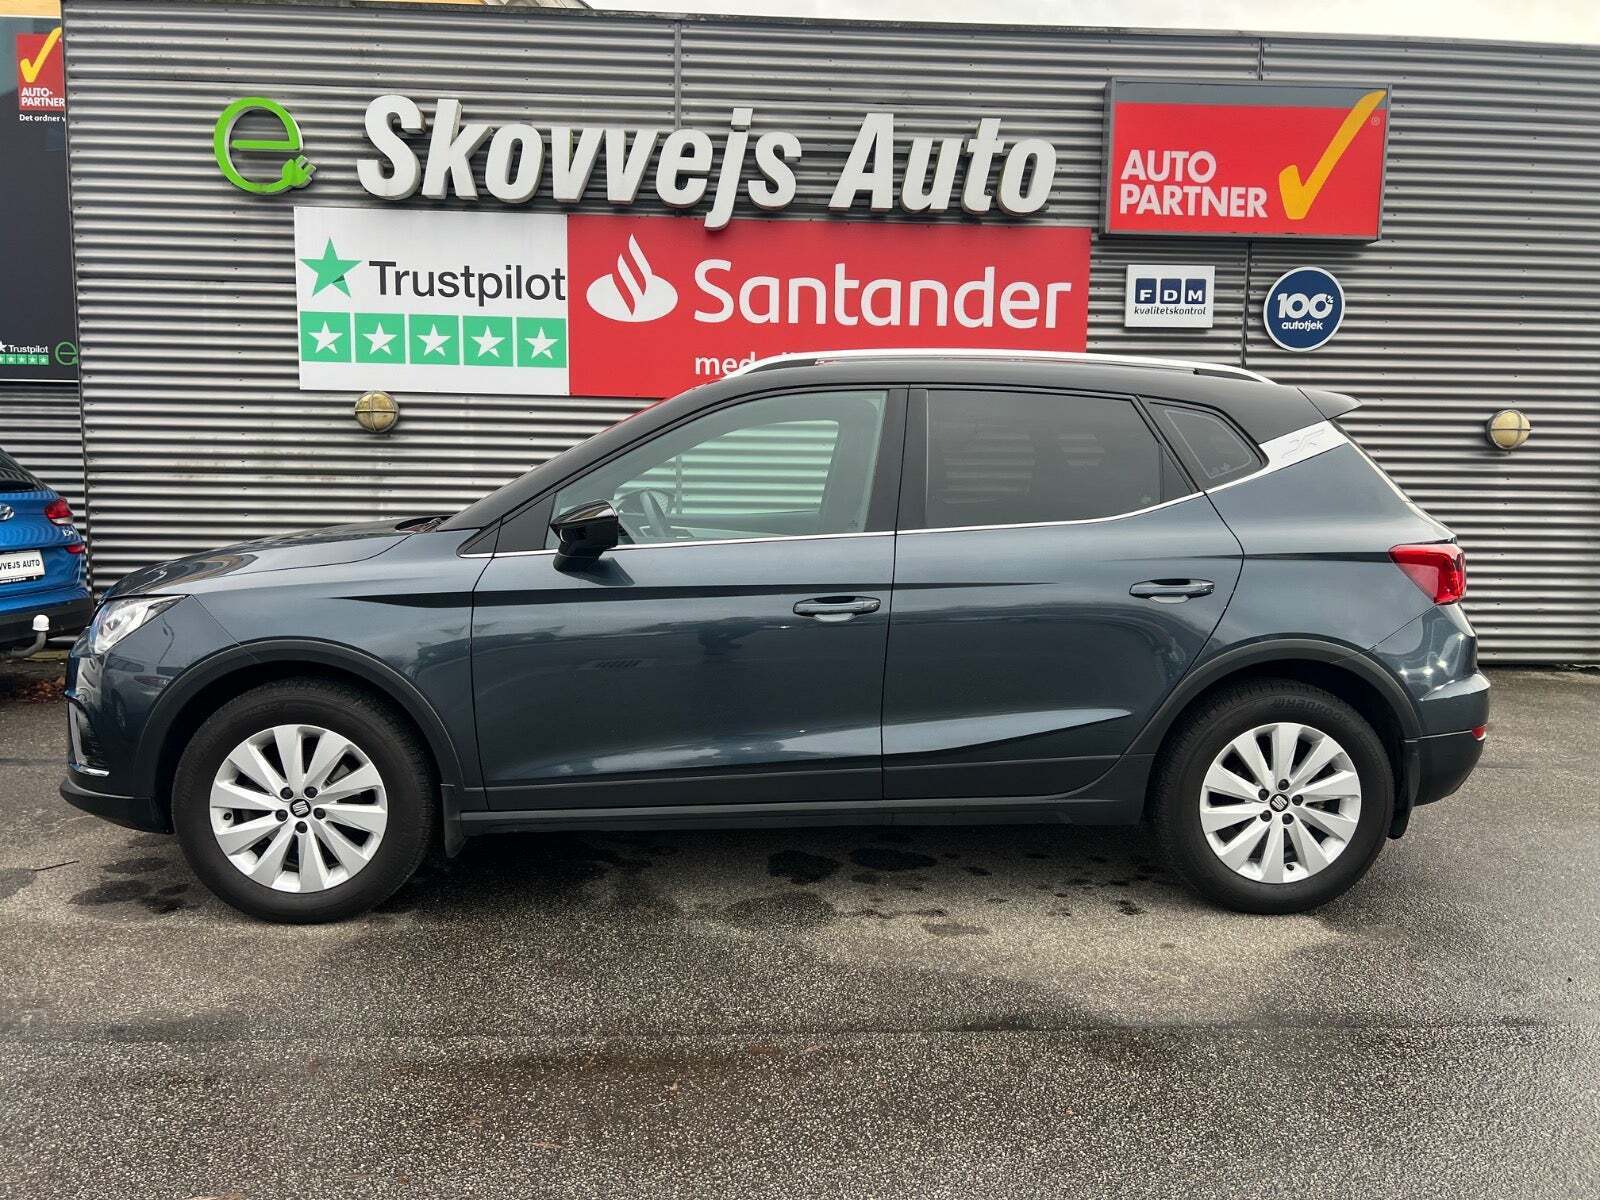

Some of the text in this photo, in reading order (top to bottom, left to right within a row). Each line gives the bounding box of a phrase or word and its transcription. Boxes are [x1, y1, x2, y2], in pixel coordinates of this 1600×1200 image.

[21, 87, 53, 97] AUTO-
[21, 97, 65, 107] PARTNER
[357, 94, 1058, 231] Skovvejs Auto
[1120, 149, 1217, 183] AUTO
[1120, 184, 1268, 218] PARTNER
[368, 260, 566, 307] Trustpilot
[693, 258, 1072, 329] Santander
[1139, 289, 1203, 302] FDM
[1134, 306, 1206, 315] kvalitetskontrol
[1281, 320, 1323, 332] autotjek
[9, 344, 49, 354] Trustpilot
[23, 559, 40, 567] AUTO
